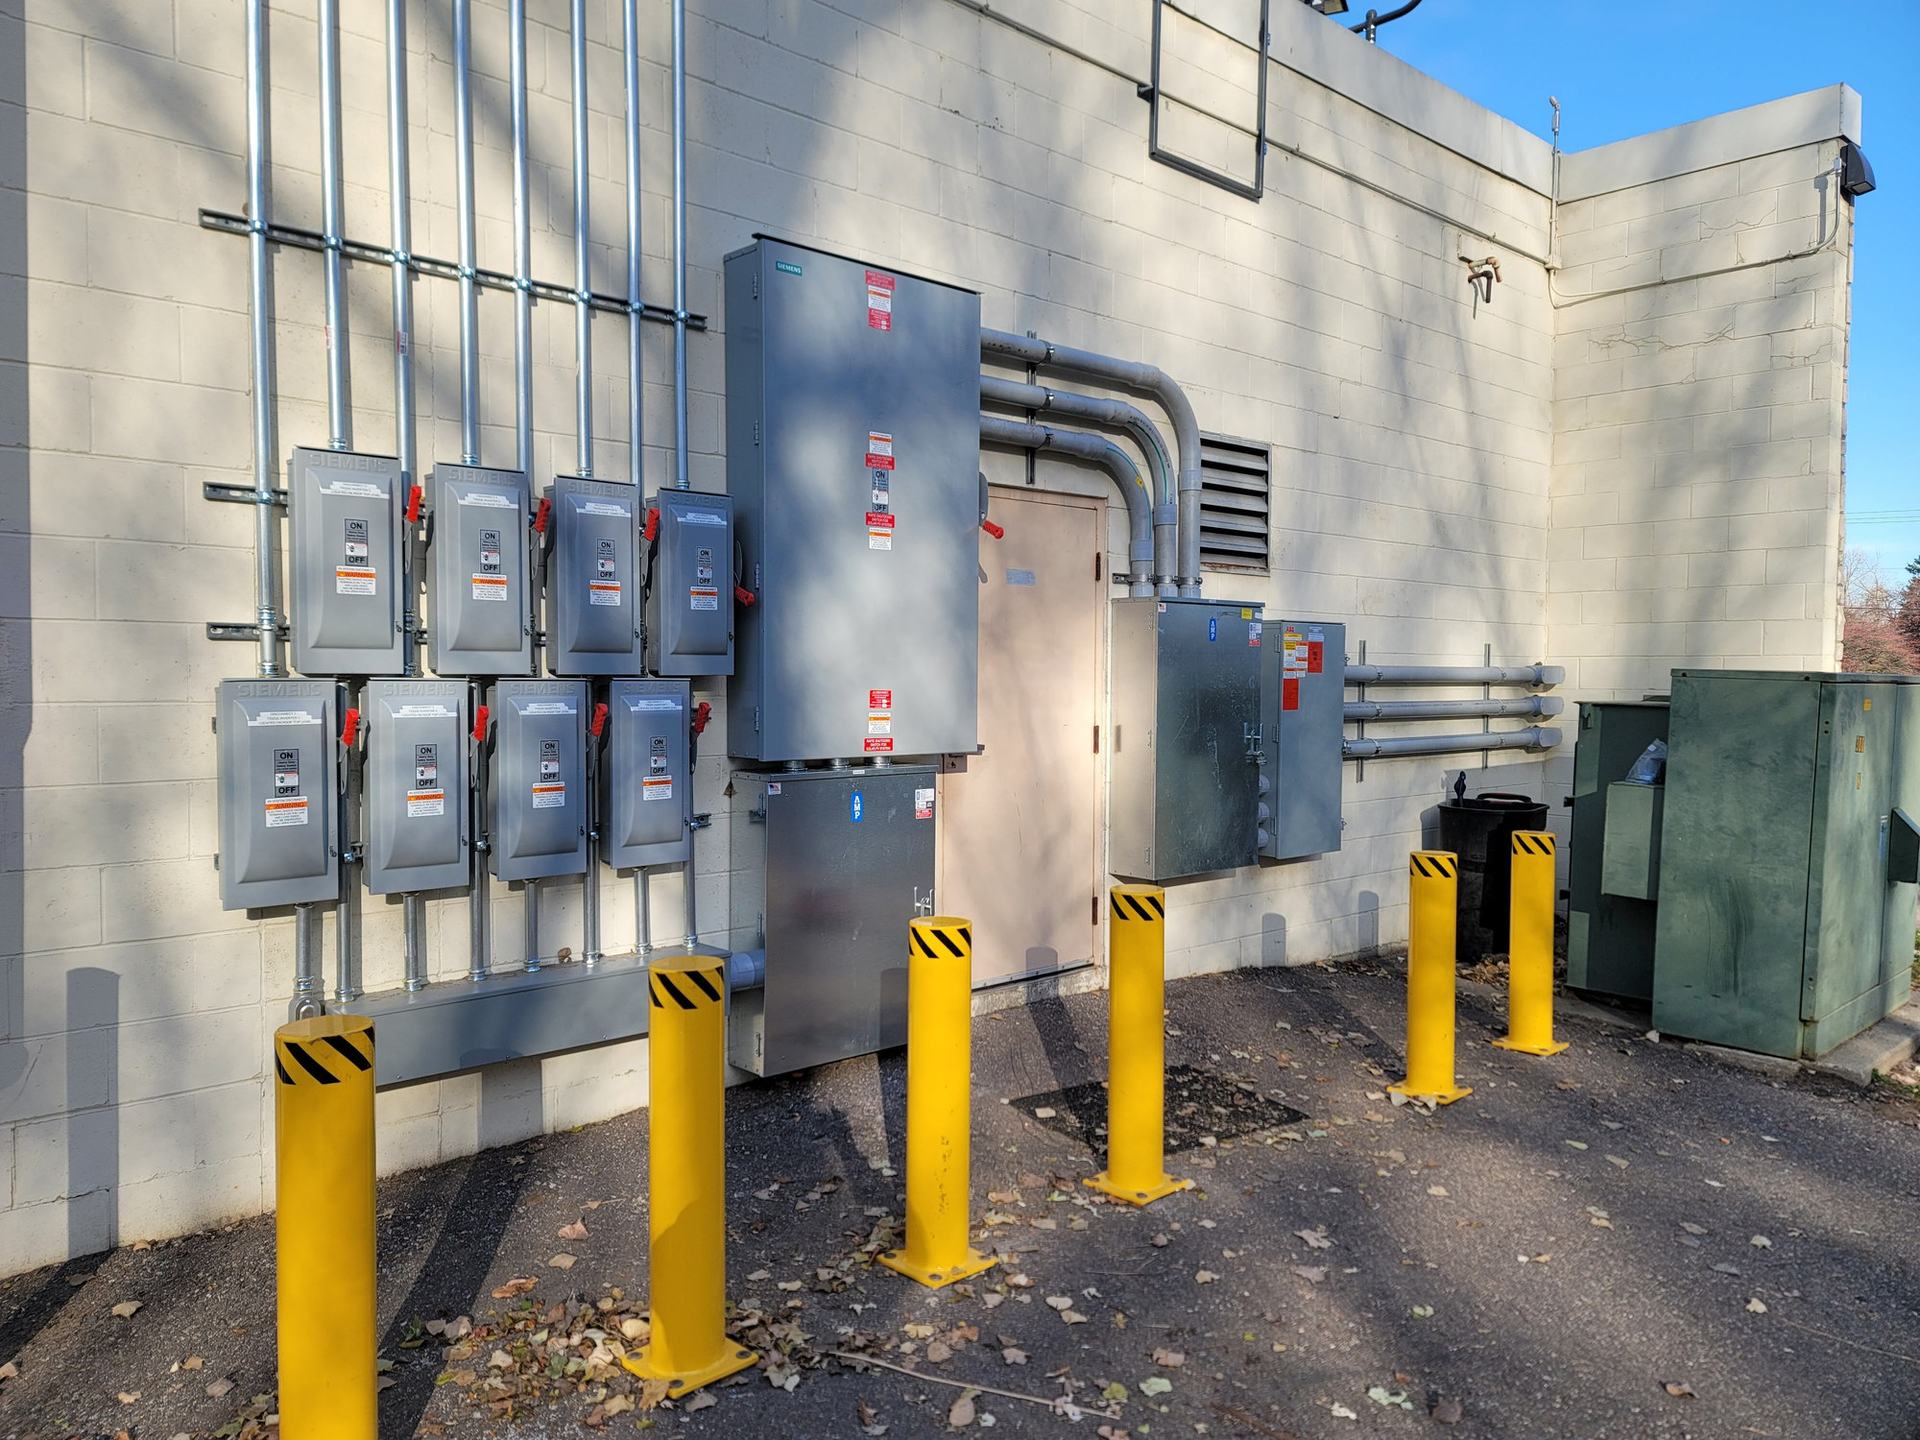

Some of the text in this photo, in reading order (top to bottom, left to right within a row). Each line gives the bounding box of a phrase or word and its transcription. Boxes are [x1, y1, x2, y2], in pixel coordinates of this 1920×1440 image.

[777, 262, 801, 274] SIEMENS
[310, 454, 388, 473] SIEMENS
[448, 468, 517, 487] SIEMENS
[568, 481, 629, 497] SIEMENS
[348, 556, 366, 564] OFF
[238, 683, 321, 697] SIEMENS
[384, 683, 457, 697] SIEMENS
[511, 683, 577, 696] SIEMENS
[280, 752, 293, 760] ON
[279, 786, 296, 794] OFF
